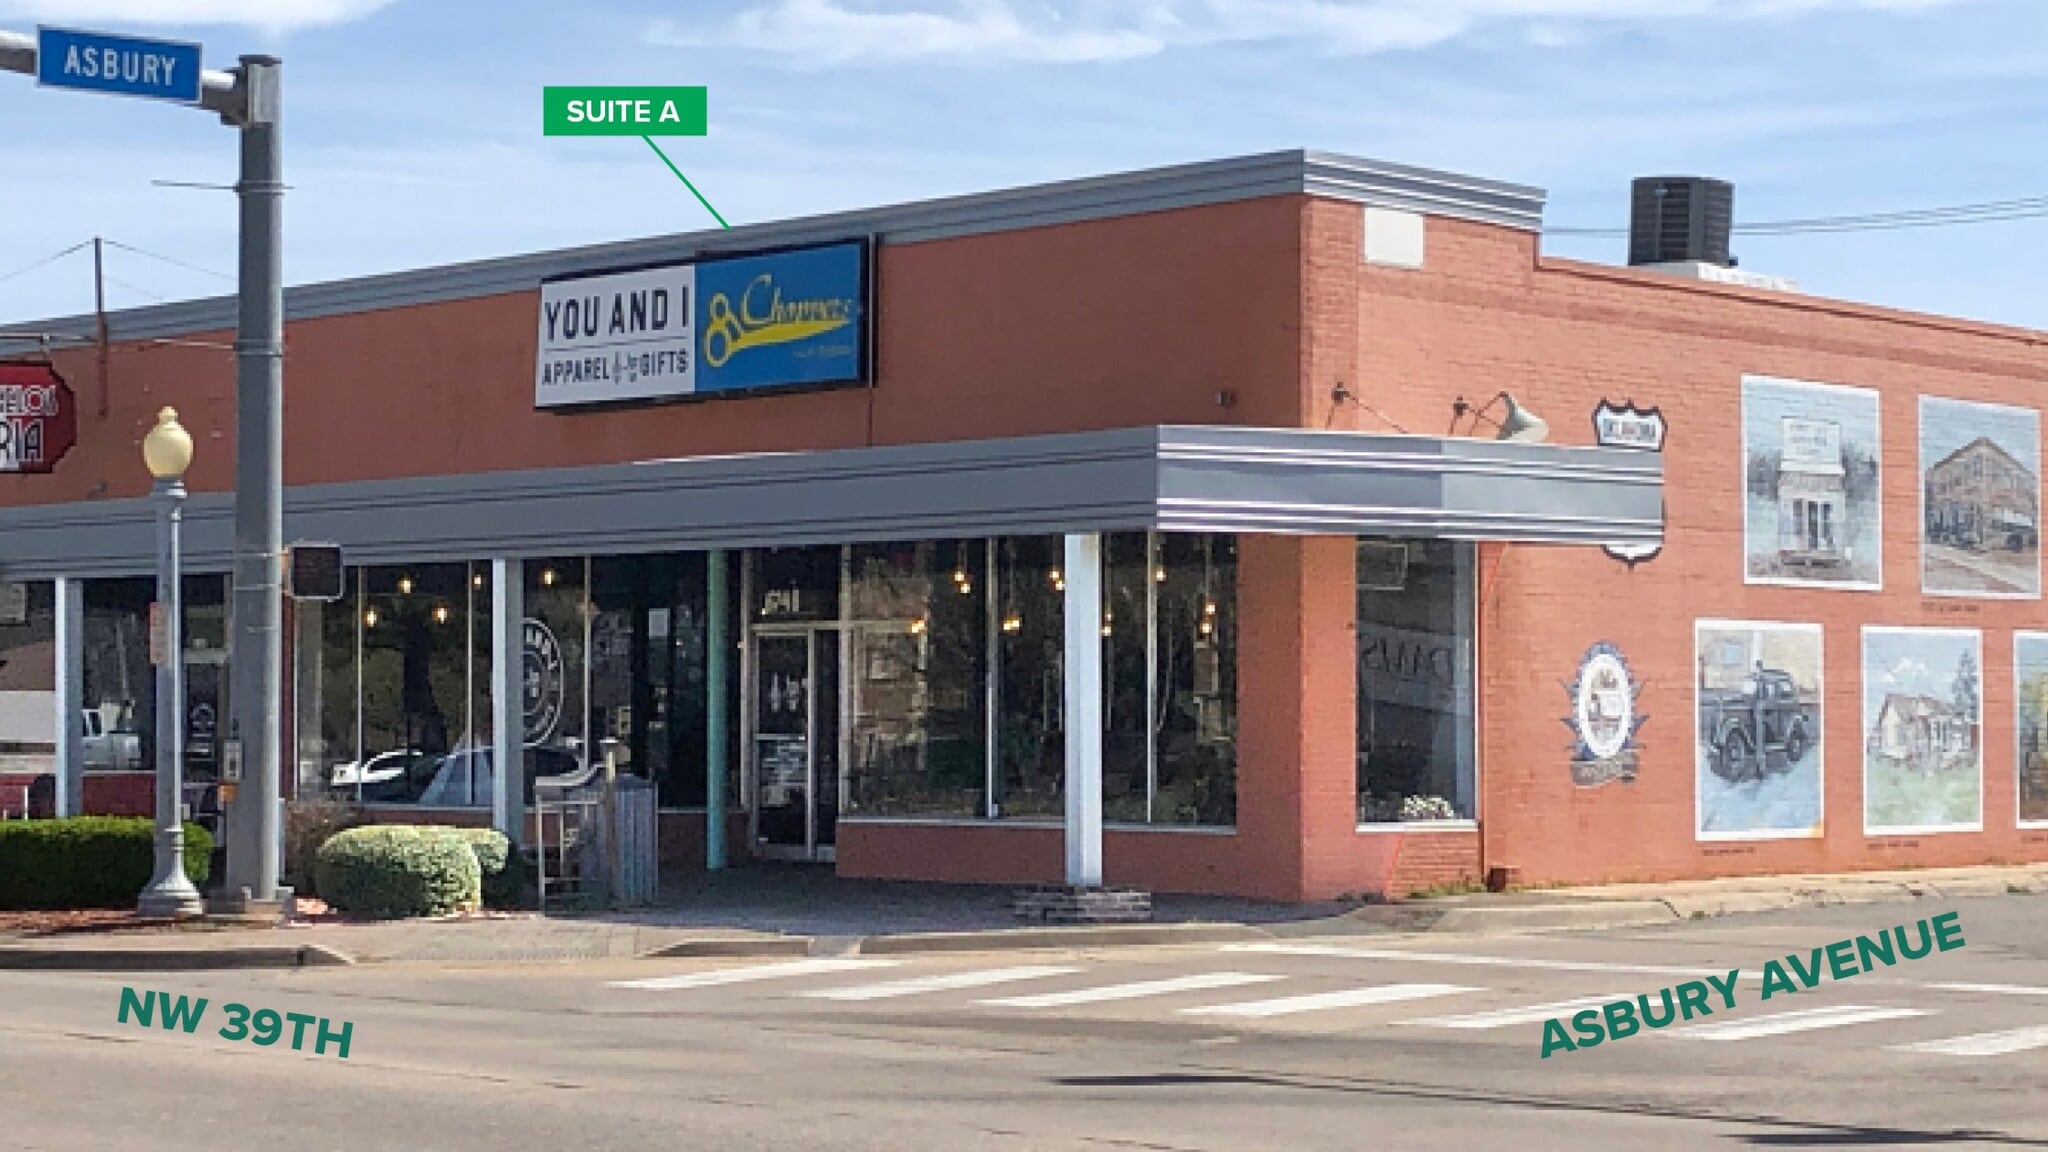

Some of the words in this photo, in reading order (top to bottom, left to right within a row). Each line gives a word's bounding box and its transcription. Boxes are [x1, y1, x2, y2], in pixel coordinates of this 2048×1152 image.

[63, 45, 176, 87] ASBURY
[545, 296, 600, 342] YOU
[608, 287, 669, 336] AND
[681, 284, 690, 328] I
[541, 357, 610, 386] APPAREL
[639, 348, 689, 377] GIFTS
